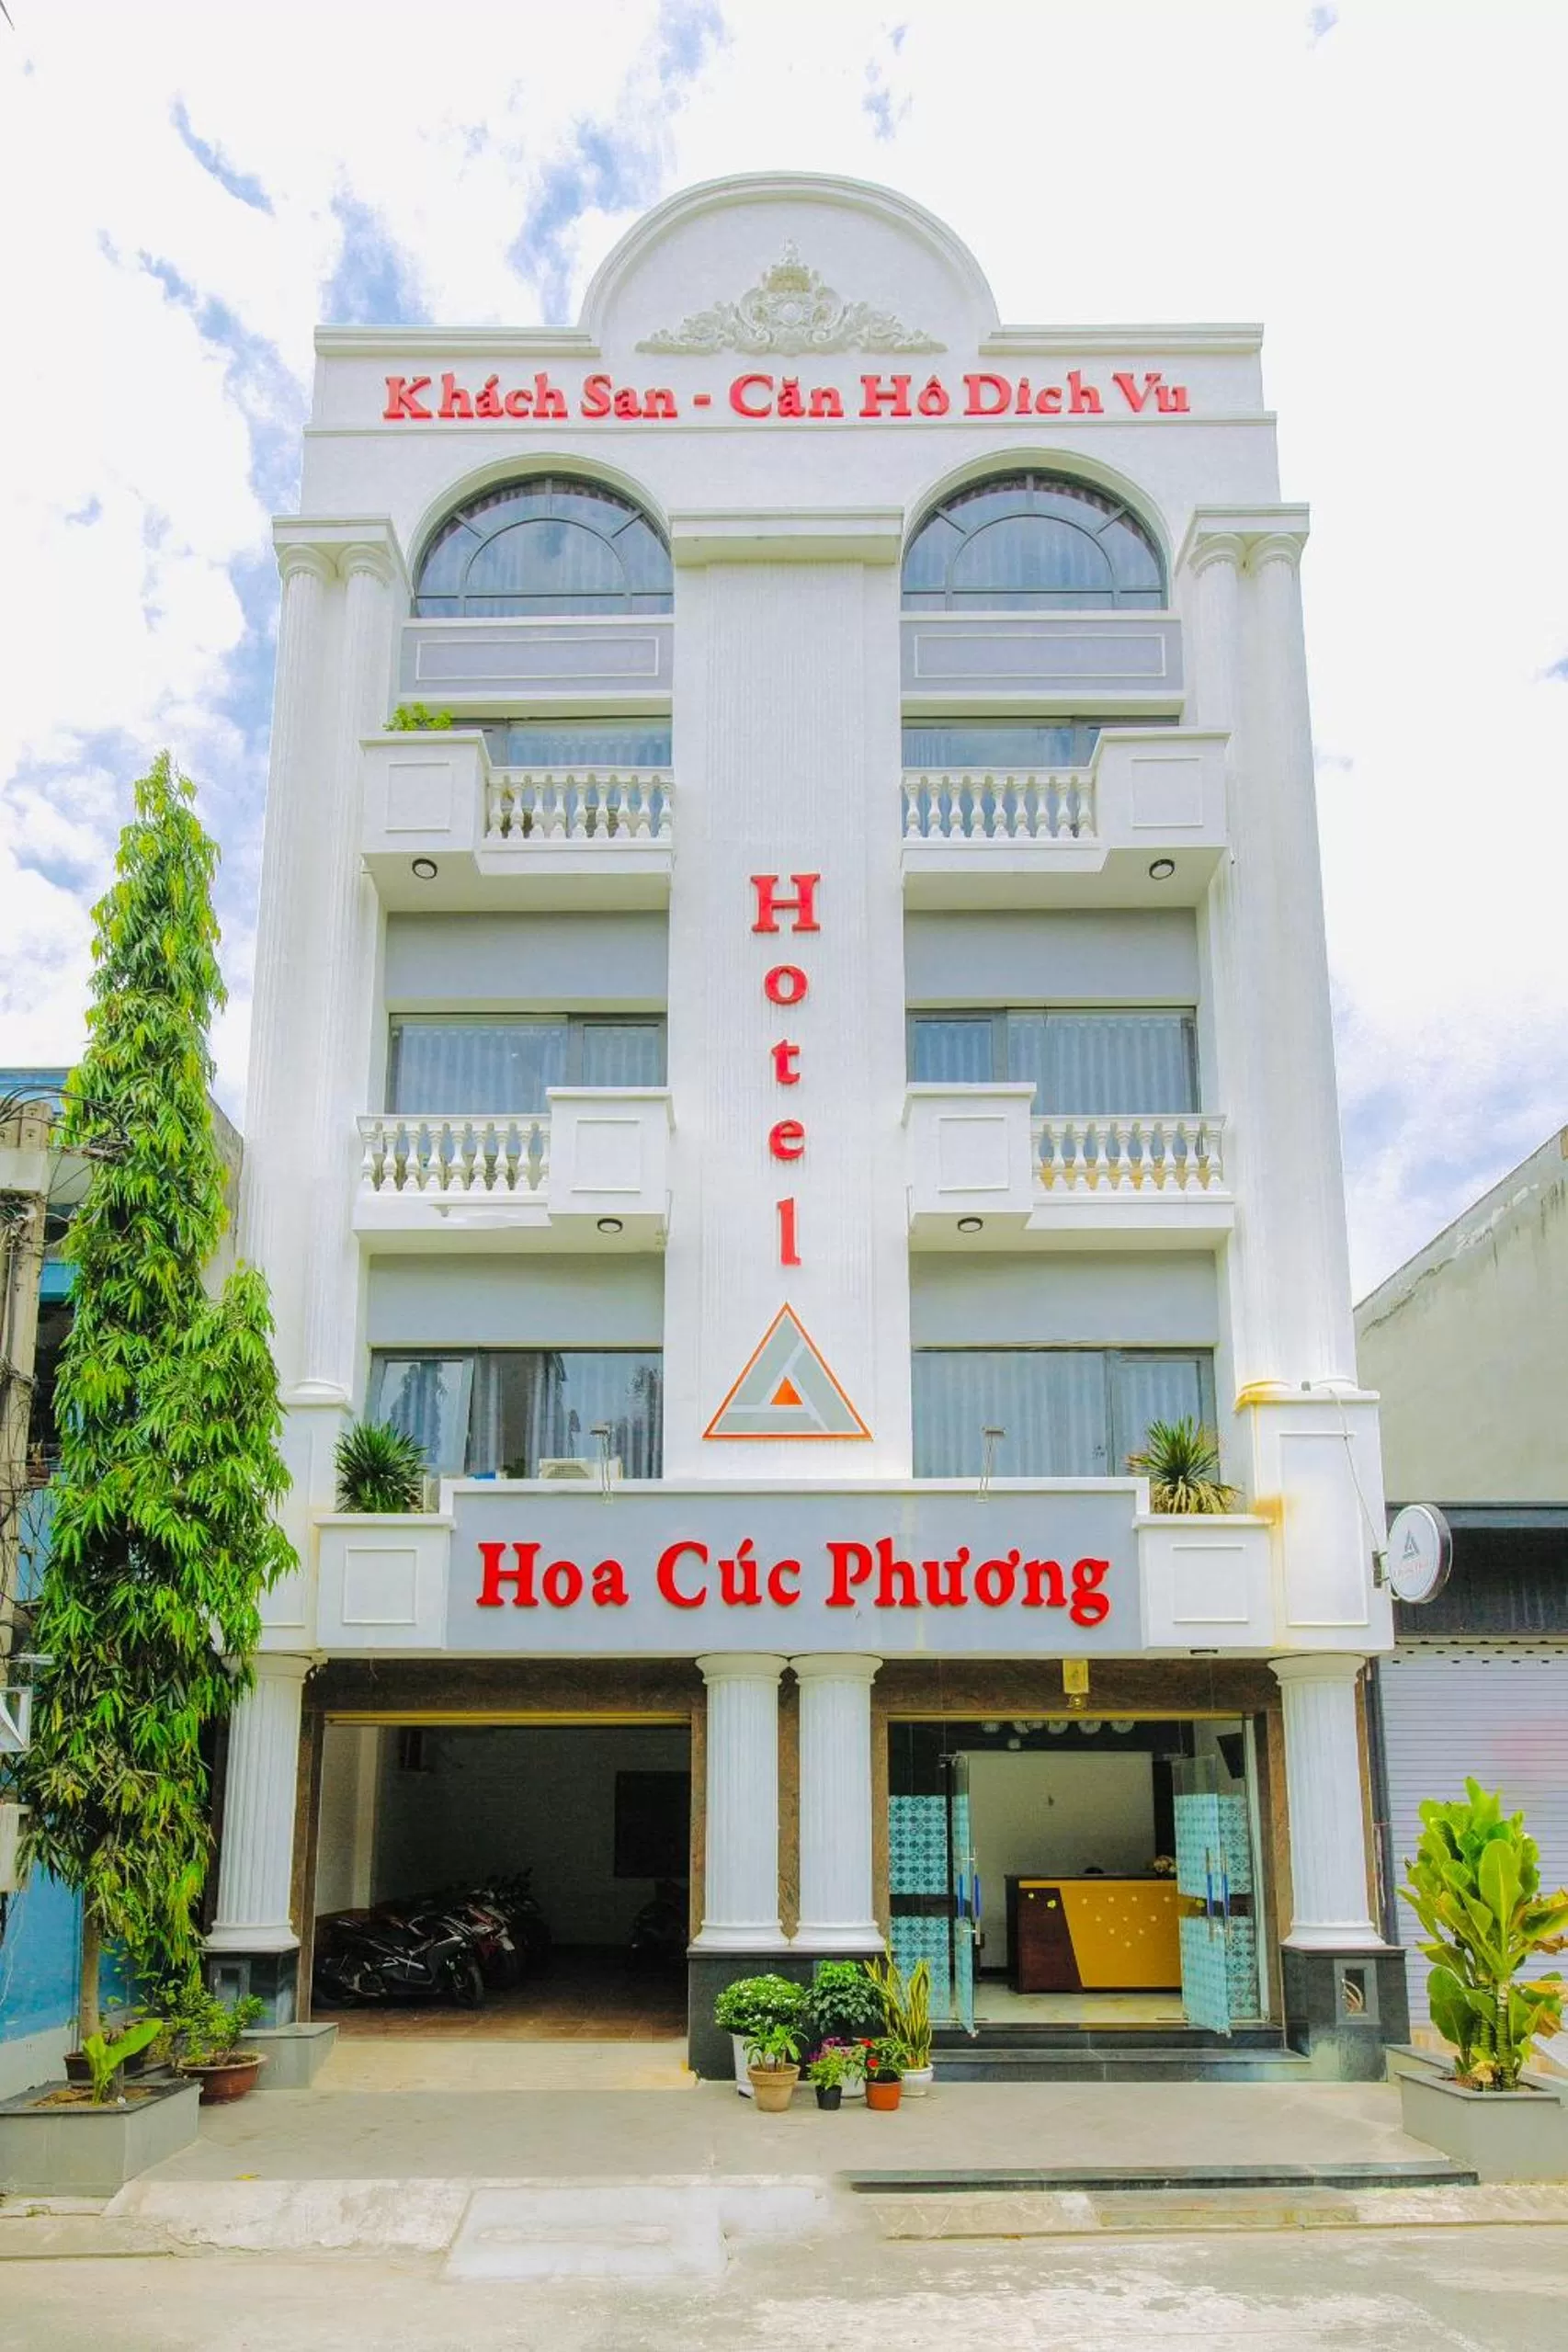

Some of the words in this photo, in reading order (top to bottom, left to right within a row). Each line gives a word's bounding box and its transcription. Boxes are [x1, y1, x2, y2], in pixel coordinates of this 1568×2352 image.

[383, 373, 568, 419] Khách
[751, 873, 821, 1266] Hotel
[476, 1541, 631, 1608] Hoa
[656, 1538, 802, 1608] Cúc
[824, 1537, 1111, 1628] Phương
